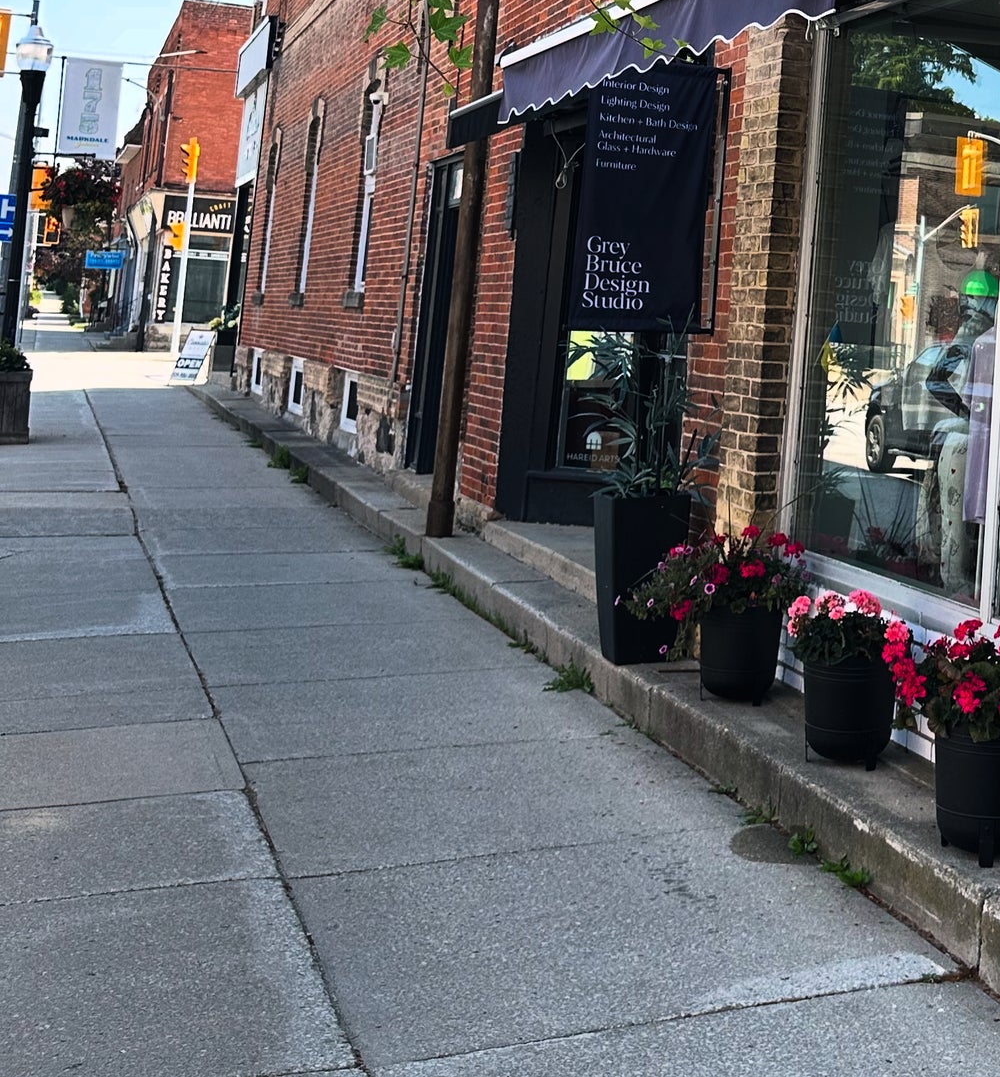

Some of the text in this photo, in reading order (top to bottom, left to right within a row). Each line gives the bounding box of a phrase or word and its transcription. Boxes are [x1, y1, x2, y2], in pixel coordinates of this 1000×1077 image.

[602, 79, 670, 95] Interior Design
[601, 95, 670, 112] Lighting Design
[599, 112, 635, 124] Kitchen
[645, 117, 667, 128] Bath
[668, 119, 698, 131] Design
[599, 129, 657, 144] Architectural
[597, 140, 621, 152] Glass
[631, 144, 677, 157] Hardware
[596, 157, 637, 171] Furniture
[587, 235, 631, 256] Grey
[586, 254, 642, 274] Bruce
[155, 248, 173, 321] BAKERY
[583, 273, 650, 297] Design
[582, 291, 643, 311] Studio
[177, 359, 203, 369] OPEN
